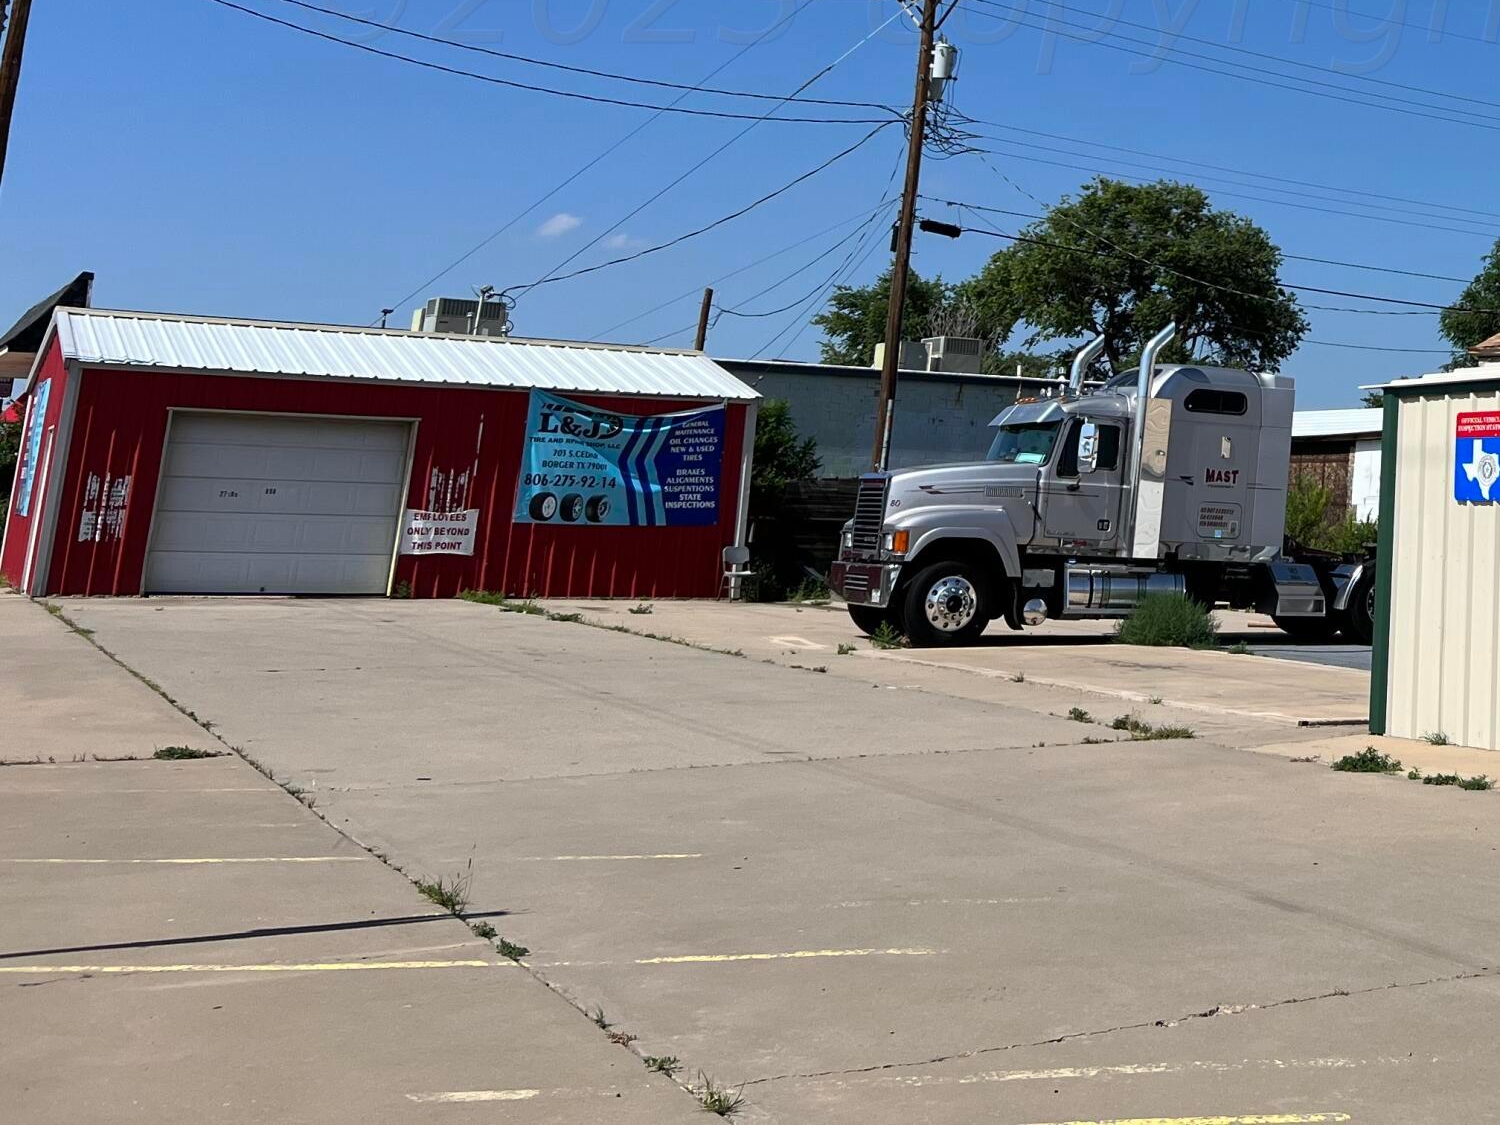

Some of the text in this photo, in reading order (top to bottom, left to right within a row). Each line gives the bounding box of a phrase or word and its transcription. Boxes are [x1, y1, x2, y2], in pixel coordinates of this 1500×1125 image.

[682, 420, 709, 428] GENERAL
[683, 436, 718, 445] CHANGES
[553, 449, 567, 457] 703
[542, 460, 574, 469] BORGER
[576, 461, 587, 469] TX
[676, 468, 706, 476] BRAKES
[1205, 467, 1240, 484] MAST
[524, 473, 617, 489] 806-275-92-14
[679, 493, 702, 501] STATE
[665, 501, 716, 509] INSPECTIONS
[407, 527, 470, 536] ONLY BEYOND
[412, 541, 462, 550] THIS POINT
